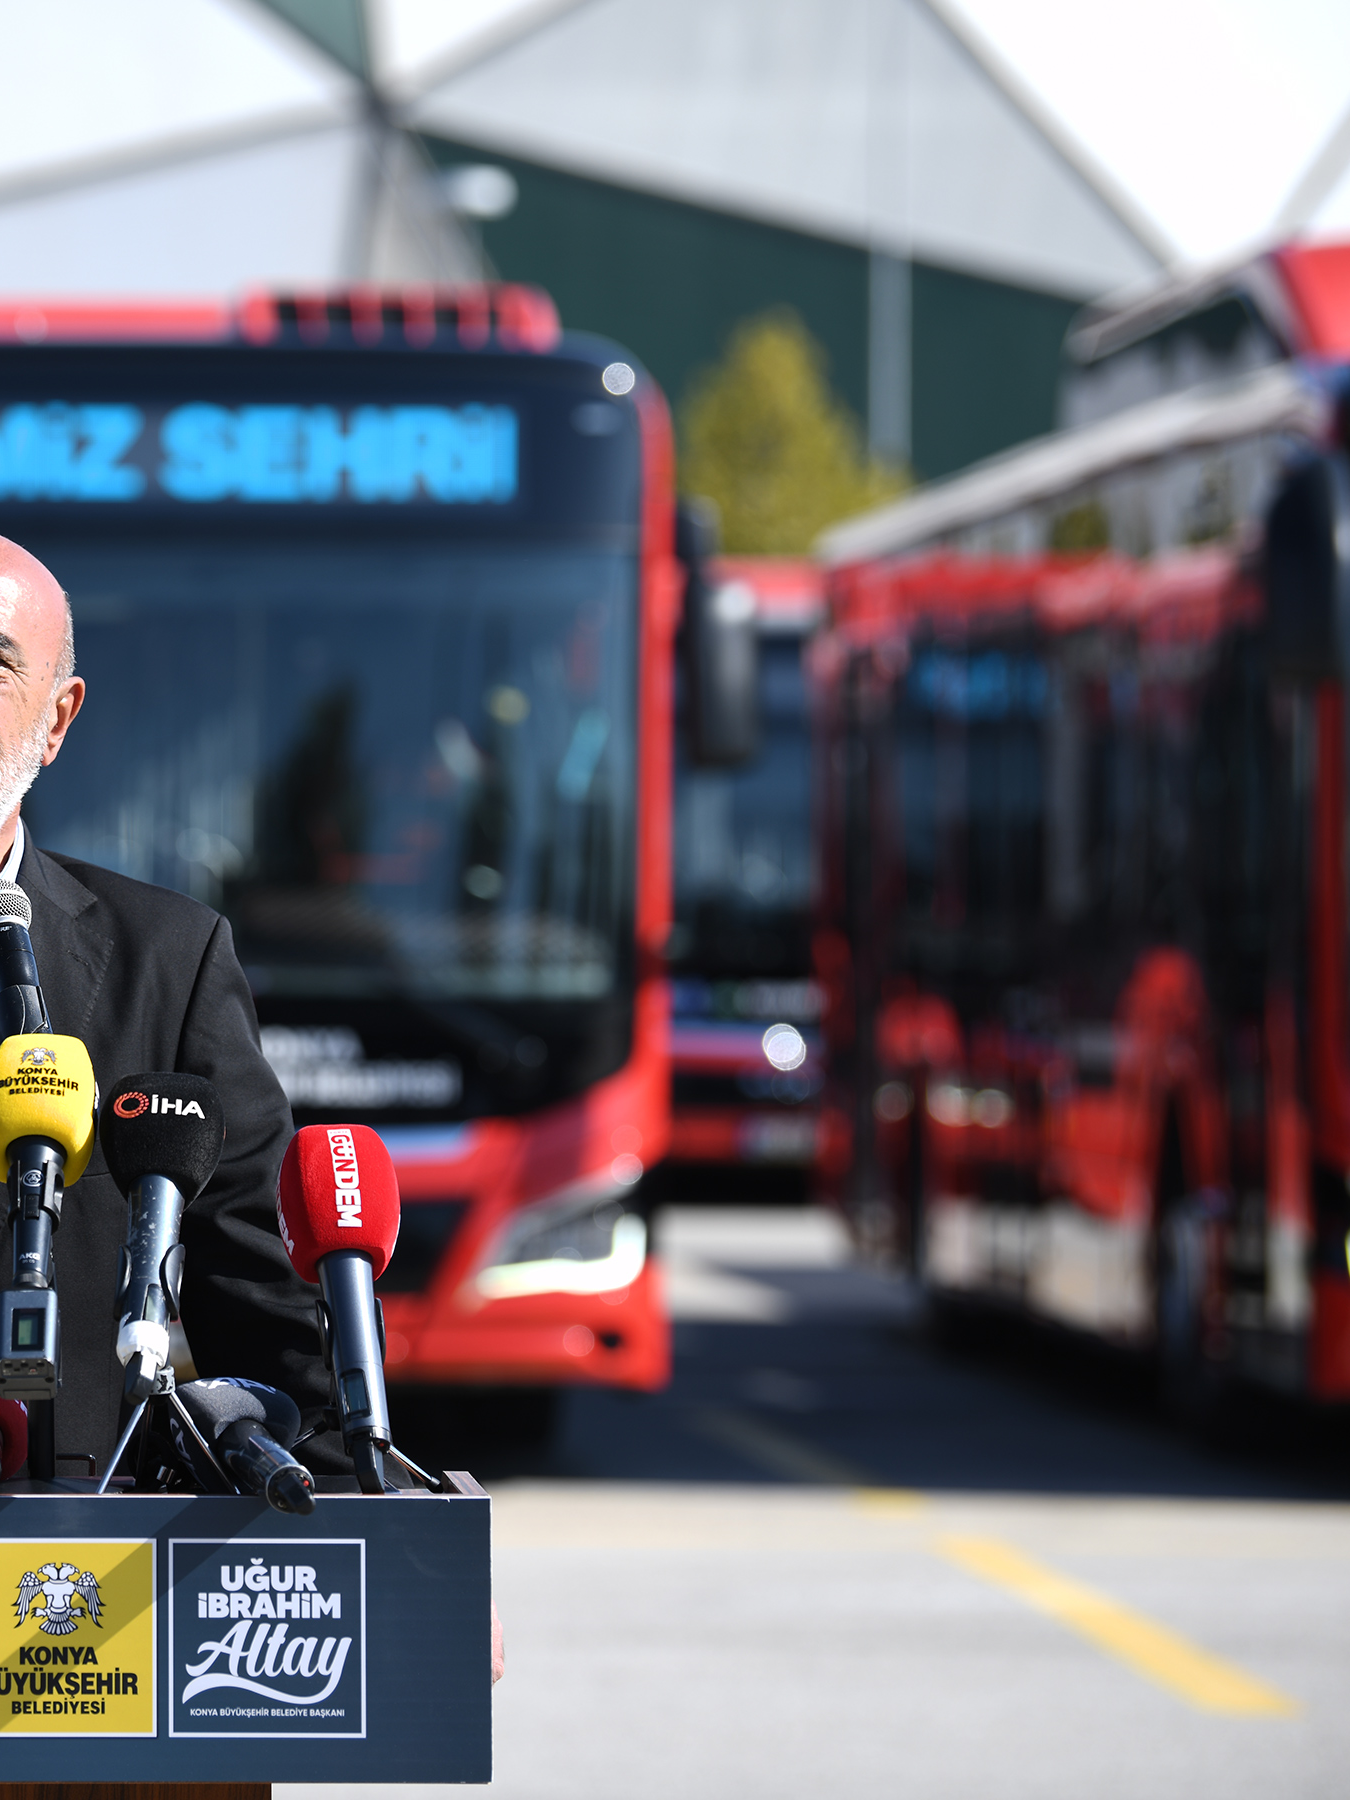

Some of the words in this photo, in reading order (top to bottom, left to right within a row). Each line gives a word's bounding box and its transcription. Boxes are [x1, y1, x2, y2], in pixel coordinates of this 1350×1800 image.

[17, 1067, 58, 1075] KONYA
[330, 1133, 363, 1228] GÜNDEM
[220, 1557, 318, 1592] UĞUR
[19, 1646, 98, 1666] KONYA
[182, 1619, 353, 1705] Altay
[11, 1698, 105, 1715] BELEDİYESİ
[190, 1708, 218, 1716] KONYA
[310, 1708, 345, 1718] BAŞKANI
